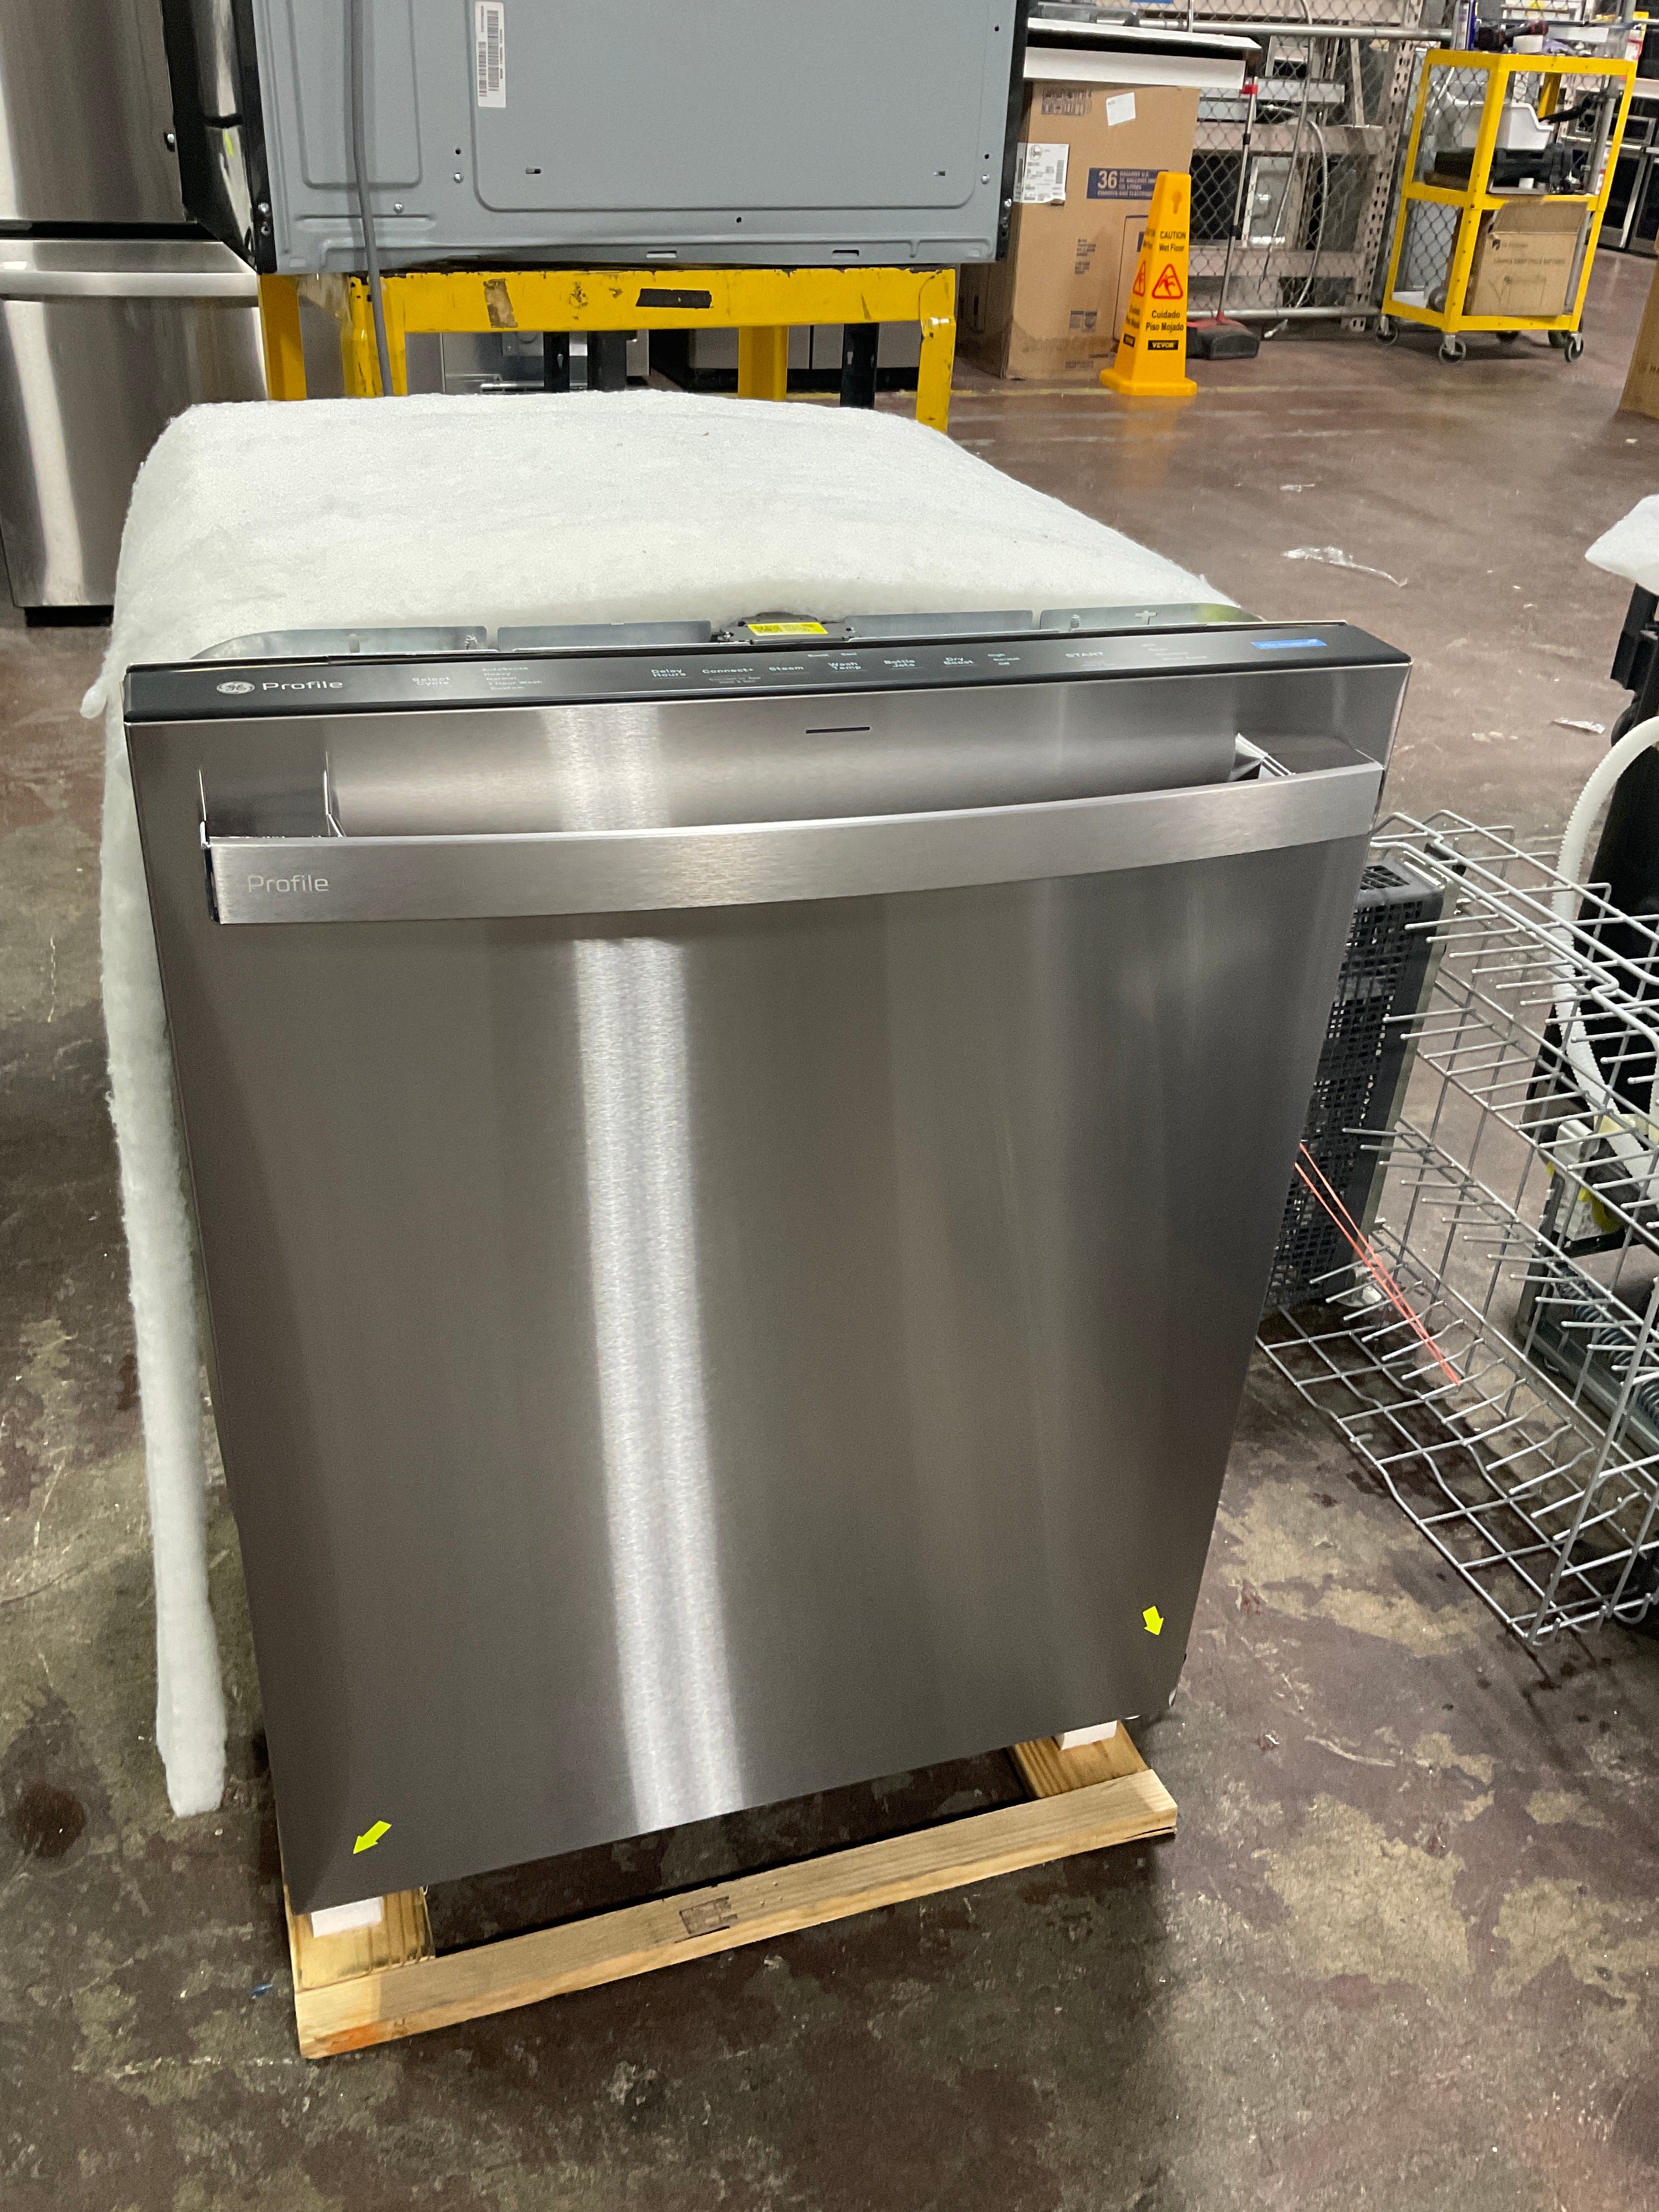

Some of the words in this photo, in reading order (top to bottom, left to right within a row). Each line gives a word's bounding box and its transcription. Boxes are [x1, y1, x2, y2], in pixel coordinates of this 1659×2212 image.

[1097, 170, 1118, 189] 36
[1160, 231, 1186, 239] CAUTION
[1152, 310, 1180, 318] Cuidado
[1146, 322, 1159, 331] Piso
[1161, 323, 1184, 332] Mojado
[262, 681, 343, 690] Profile
[247, 874, 329, 893] Profile
